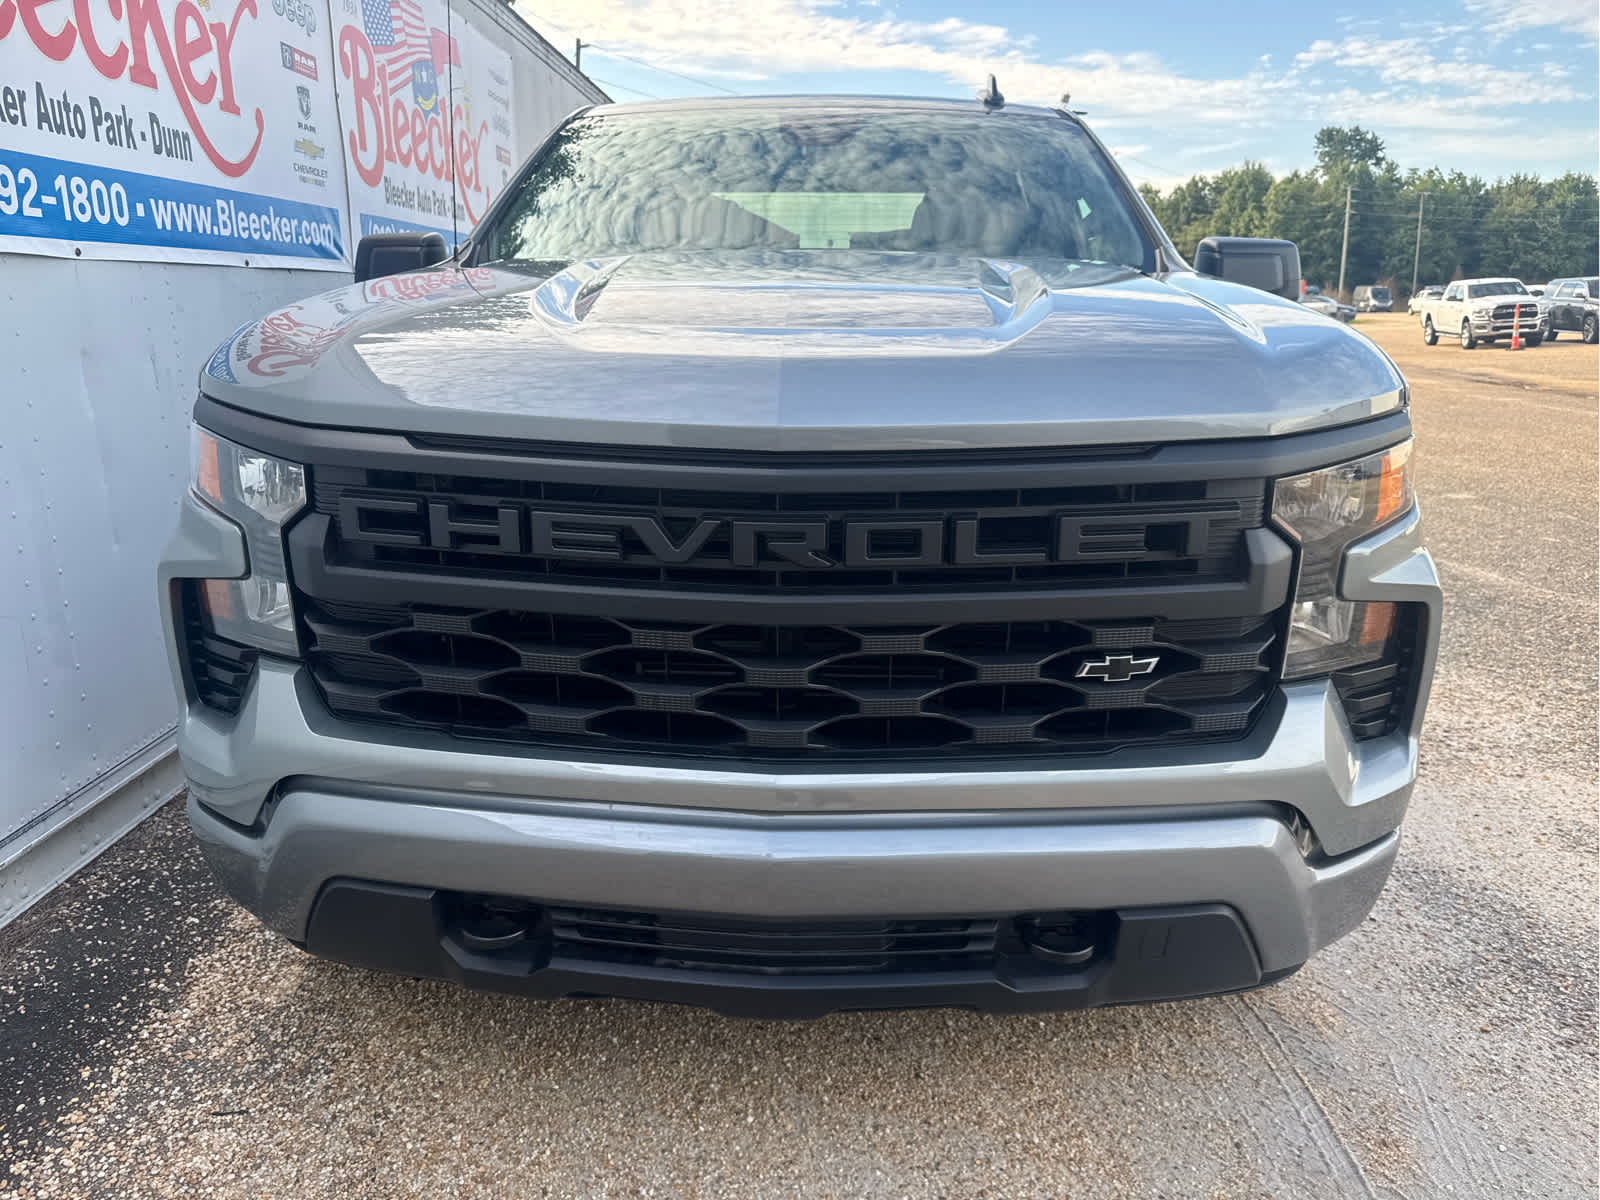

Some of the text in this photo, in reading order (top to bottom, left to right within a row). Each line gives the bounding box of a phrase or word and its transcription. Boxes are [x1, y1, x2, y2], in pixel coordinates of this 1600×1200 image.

[0, 85, 28, 128] er
[35, 81, 87, 140] Auto
[88, 95, 138, 151] Park
[148, 111, 193, 162] Dunn
[339, 25, 489, 226] Bleecker
[149, 198, 336, 248] www.Bleecker.com
[338, 496, 1241, 569] CHEVROLET
